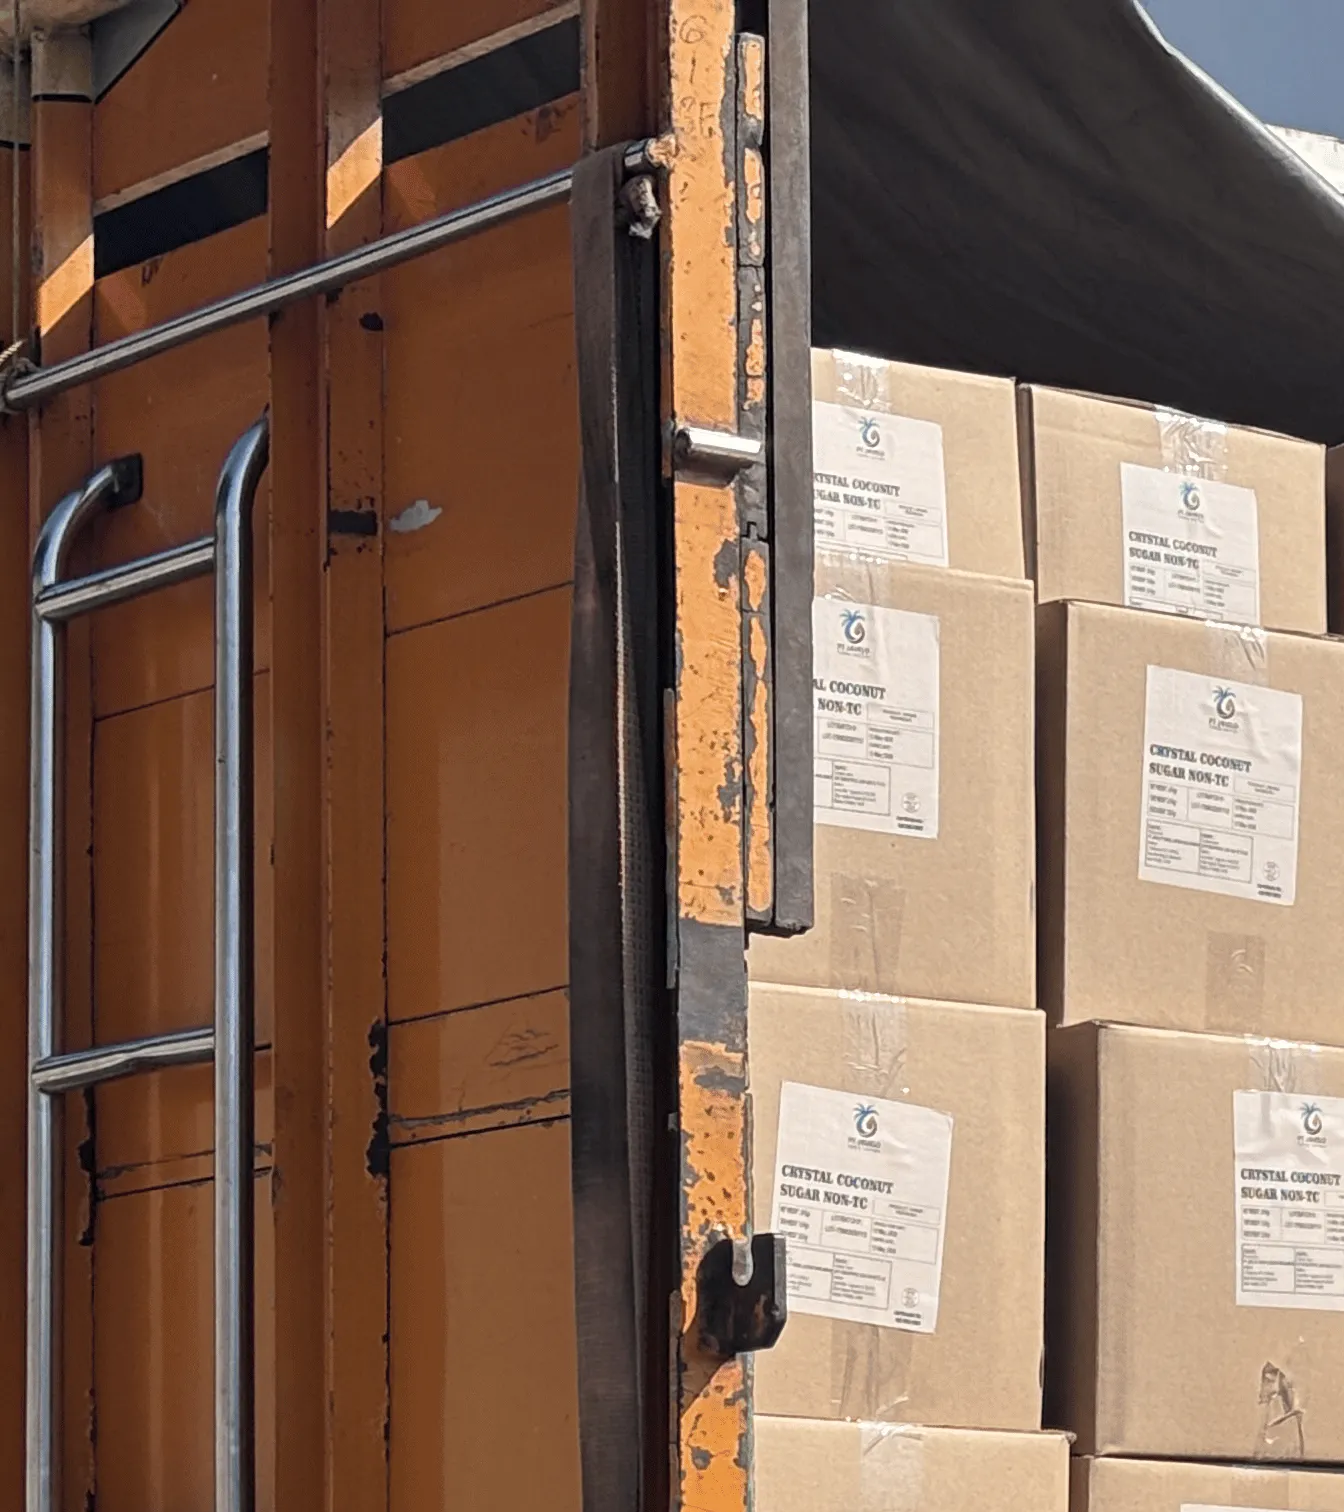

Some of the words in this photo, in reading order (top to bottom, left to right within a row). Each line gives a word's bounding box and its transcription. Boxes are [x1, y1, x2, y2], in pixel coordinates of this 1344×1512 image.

[852, 478, 900, 497] COCONUT
[1129, 531, 1171, 549] CRYSTAL
[1173, 539, 1218, 558] COCONUT
[1129, 547, 1161, 562] SUGAR
[829, 680, 886, 700] COCONUT
[817, 698, 862, 716] NON-TC
[1150, 744, 1197, 763] CRYSTAL
[1200, 752, 1252, 773] COCONUT
[1149, 762, 1186, 780] SUGAR
[1188, 769, 1229, 787] NON-TC
[781, 1164, 834, 1184] CRYSTAL
[837, 1173, 894, 1194] COCONUT
[1241, 1168, 1288, 1183] CRYSTAL
[1290, 1171, 1342, 1186] COCONUT
[780, 1184, 820, 1202] SUGAR
[823, 1192, 868, 1210] NON-TC
[1241, 1186, 1278, 1201] SUGAR
[1280, 1189, 1320, 1203] NON-TC
